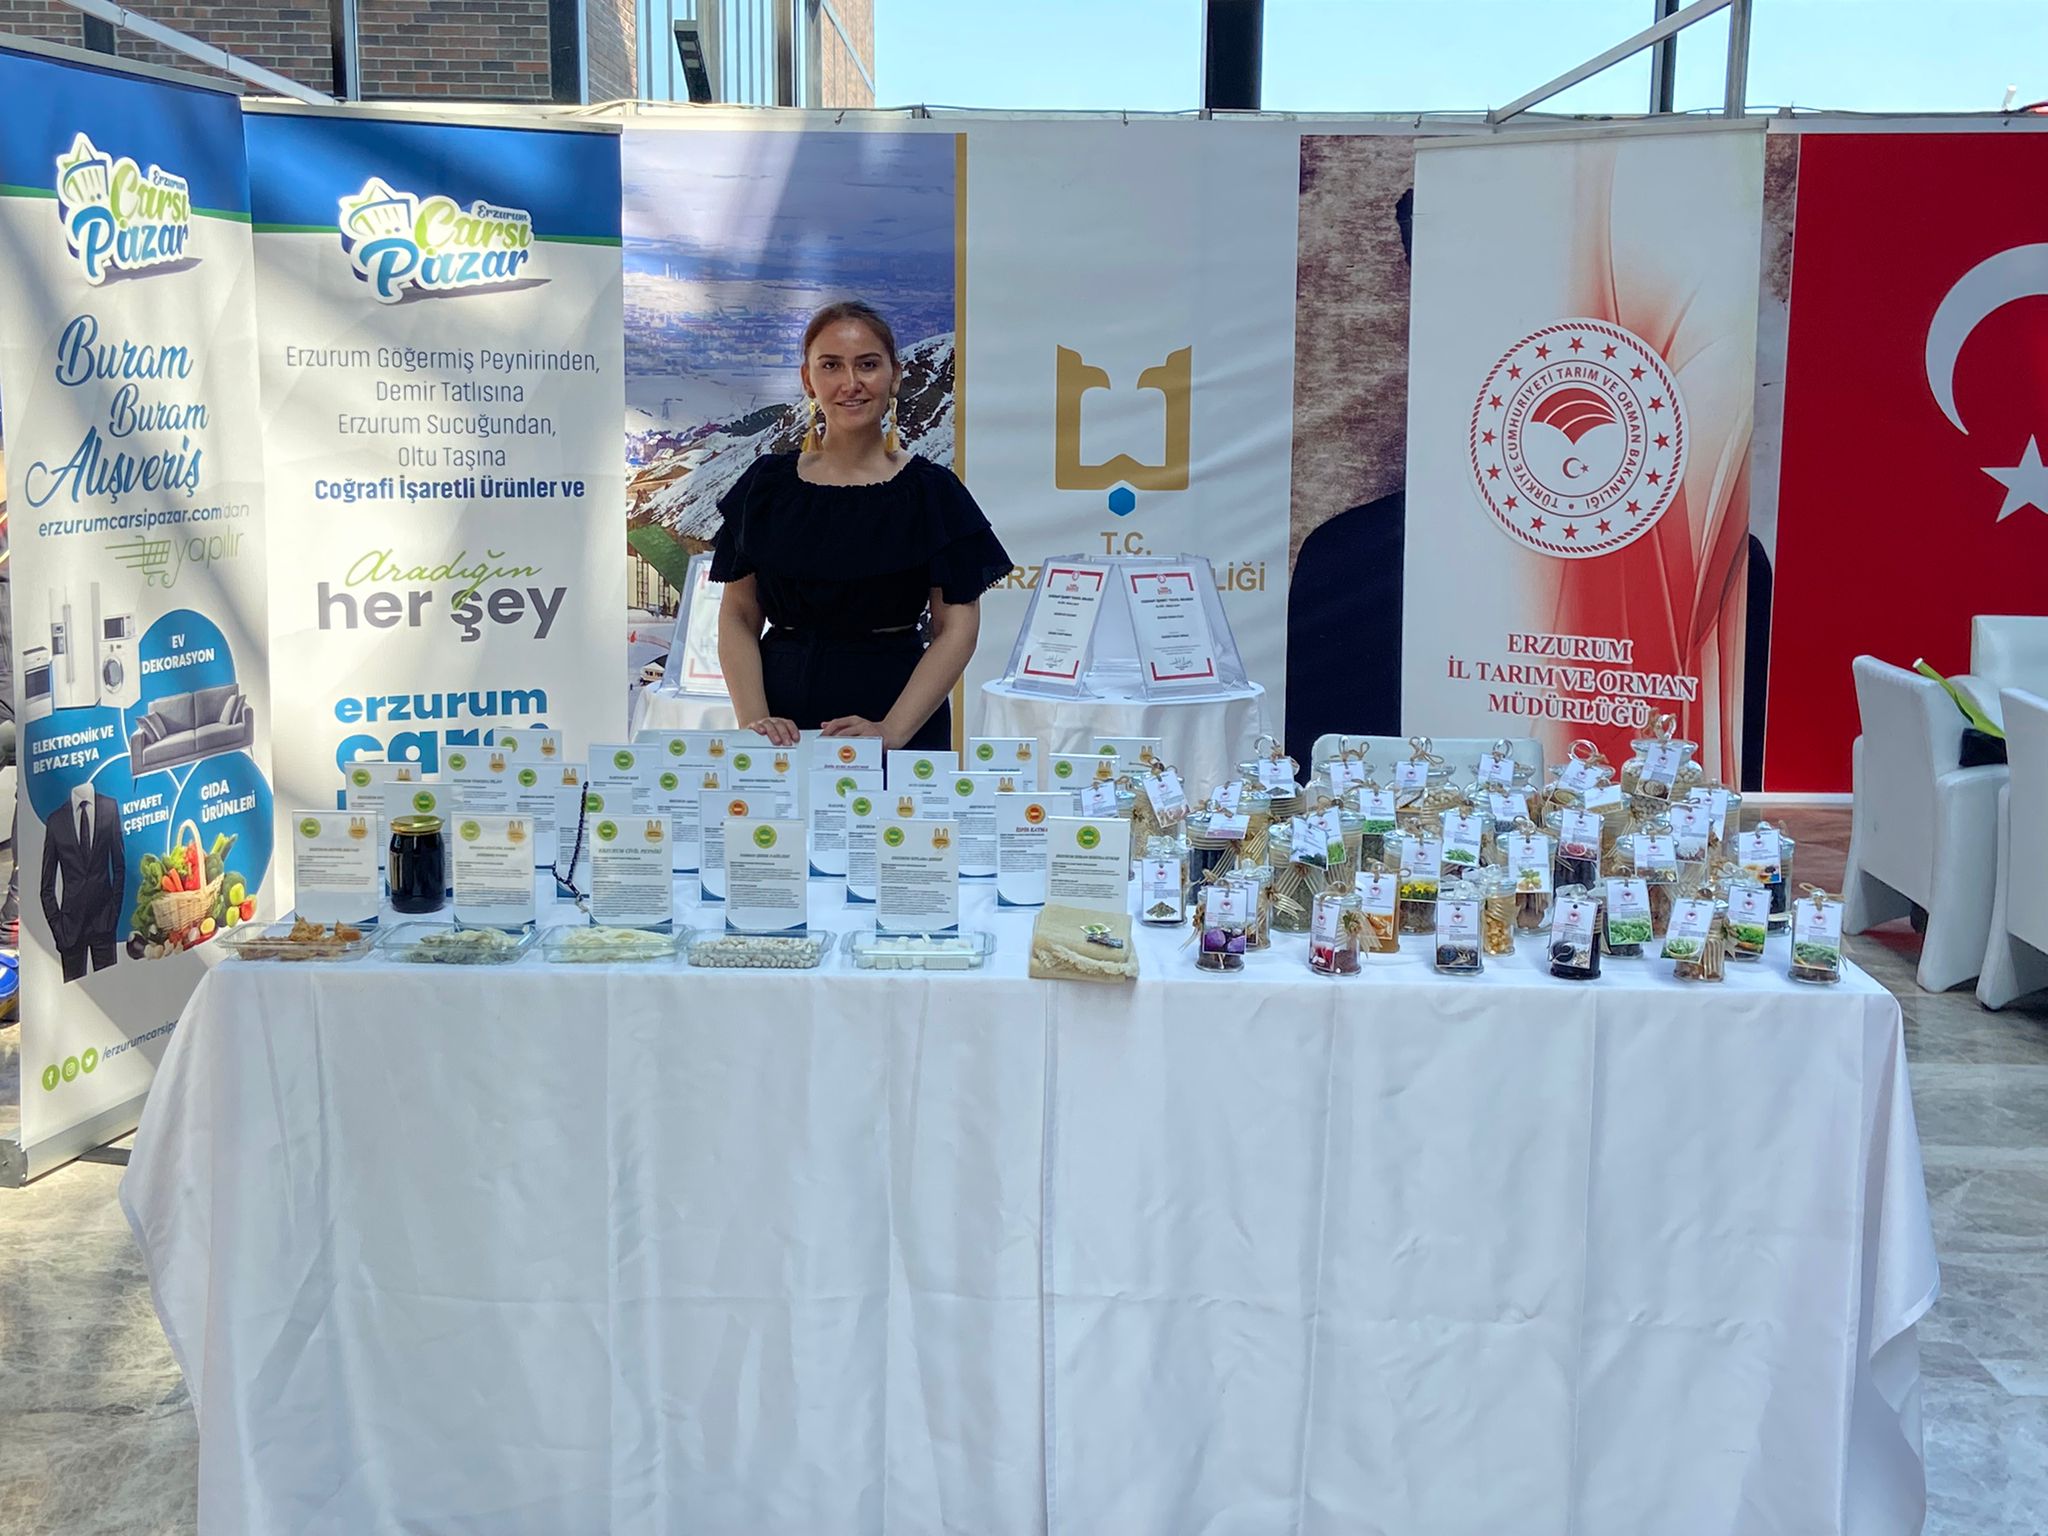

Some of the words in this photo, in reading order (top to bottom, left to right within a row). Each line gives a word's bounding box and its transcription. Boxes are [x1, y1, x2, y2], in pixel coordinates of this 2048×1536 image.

[477, 204, 528, 221] Erzurum
[72, 205, 188, 277] Pazar
[359, 237, 529, 297] Pazar
[56, 314, 193, 387] Buram
[286, 346, 371, 367] Erzurum
[377, 347, 474, 373] Göğermiş
[480, 350, 600, 374] Peynirinden,
[1556, 366, 1599, 381] TARIM
[1602, 375, 1618, 392] VE
[376, 381, 437, 401] Demir
[441, 382, 524, 402] Tatlısına
[109, 383, 209, 437] Buram
[339, 413, 421, 434] Erzurum
[427, 413, 556, 438] Sucuğundan,
[1508, 370, 1553, 460] CUMHURİYETİ
[1618, 392, 1641, 443] ORMAN
[25, 426, 202, 508] Alışveriş
[398, 447, 437, 467] Oltu
[444, 448, 506, 470] Taşına
[314, 478, 394, 503] Coğrafi
[399, 475, 475, 503] İşaretli
[480, 477, 557, 499] Ürünler
[562, 480, 585, 498] ve
[1513, 463, 1559, 509] TÜRKİYE
[1586, 449, 1640, 509] BAKANLIĞI
[162, 525, 244, 588] yapılır
[317, 581, 433, 630] her
[450, 586, 568, 643] şey
[172, 634, 185, 649] EV
[1508, 634, 1632, 662] ERZURUM
[142, 648, 215, 674] DEKORASYON
[1448, 655, 1470, 679] İL
[1476, 662, 1555, 686] TARIM
[1558, 668, 1594, 689] VE
[1598, 672, 1698, 699] ORMAN
[334, 688, 548, 724] erzurum
[1488, 692, 1649, 727] MÜDÜRLÜĞÜ
[32, 726, 99, 755] ELEKTRONİK
[100, 724, 114, 739] VE
[33, 752, 69, 775] BEYAZ
[71, 747, 100, 768] EŞYA
[123, 793, 163, 815] KIYAFET
[201, 780, 230, 800] GIDA
[123, 805, 169, 835] ÇEŞİTLERİ
[202, 790, 256, 823] ÜRÜNLERİ
